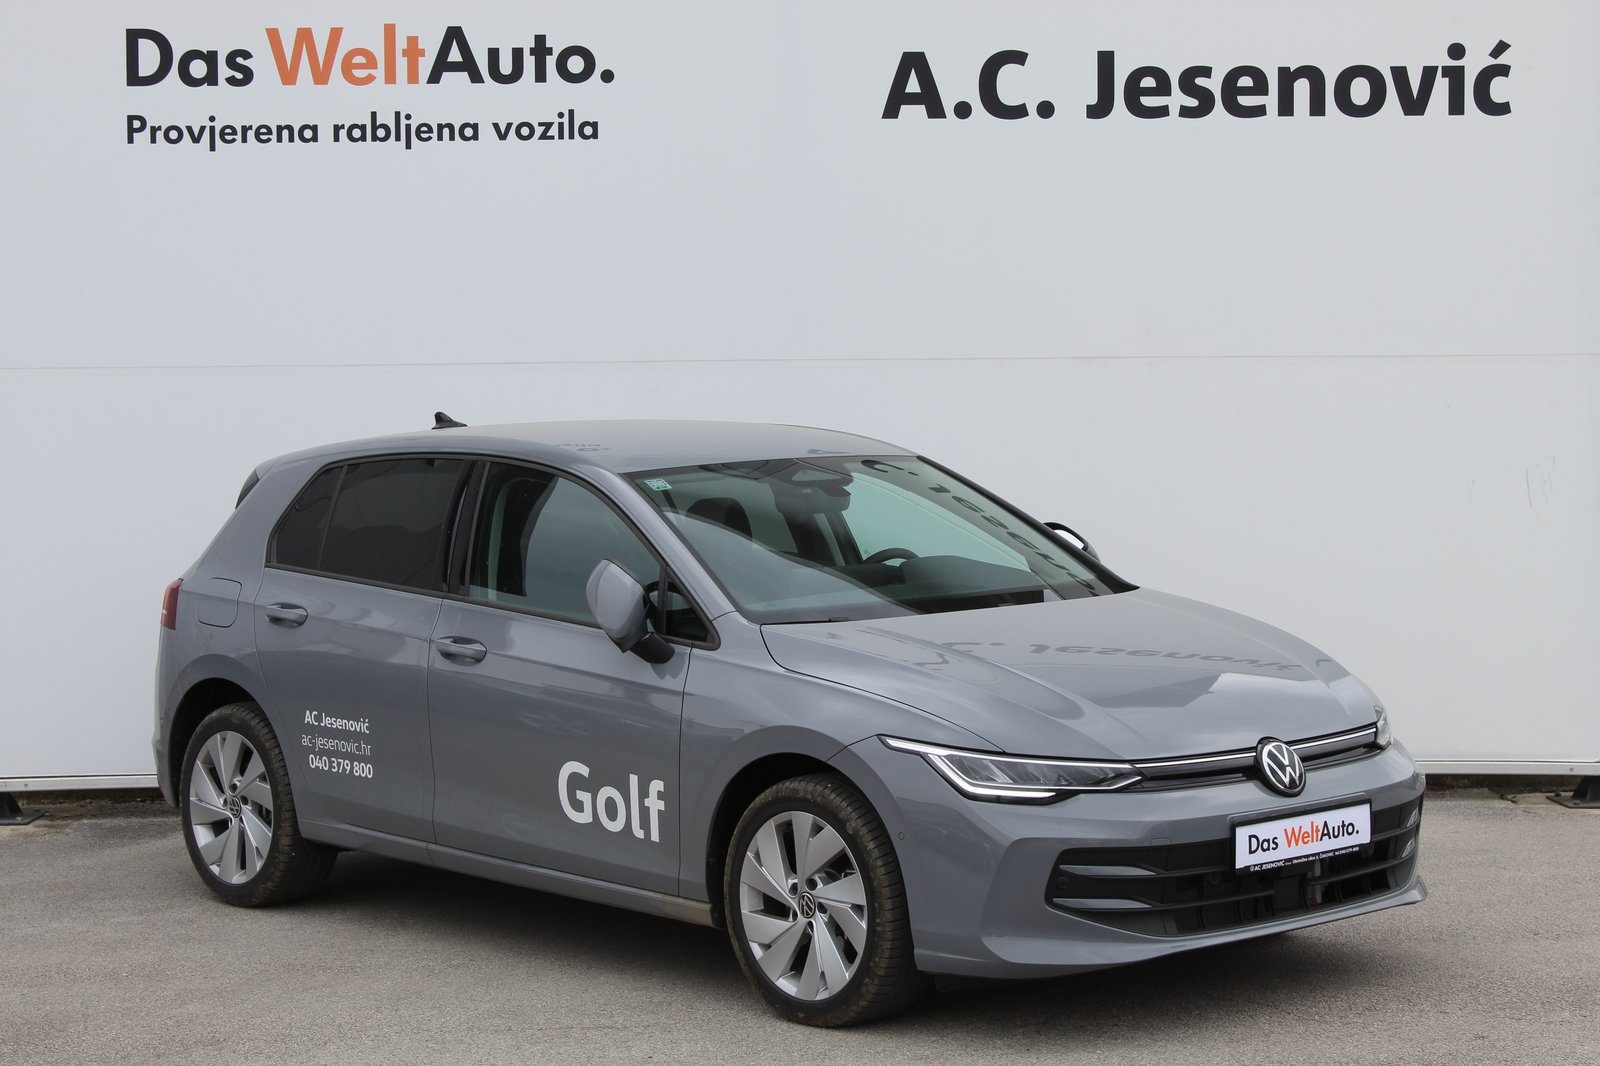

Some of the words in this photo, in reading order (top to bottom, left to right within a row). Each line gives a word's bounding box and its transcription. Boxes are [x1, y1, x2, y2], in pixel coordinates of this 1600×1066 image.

[126, 28, 254, 87] Das
[266, 23, 615, 86] WeltAuto.
[882, 49, 1056, 120] A.C.
[1086, 39, 1512, 120] Jesenović
[126, 115, 319, 151] Provjerena
[332, 111, 479, 150] rabljena
[491, 109, 599, 142] vozila
[304, 710, 319, 726] AC
[320, 712, 370, 734] Jesenović
[301, 734, 372, 756] ac-jesenovic.hr
[308, 754, 329, 771] 040
[331, 757, 351, 775] 379
[353, 761, 374, 779] 800
[558, 760, 666, 842] Golf
[1248, 834, 1279, 855] Das
[1284, 820, 1360, 848] WeltAuto.
